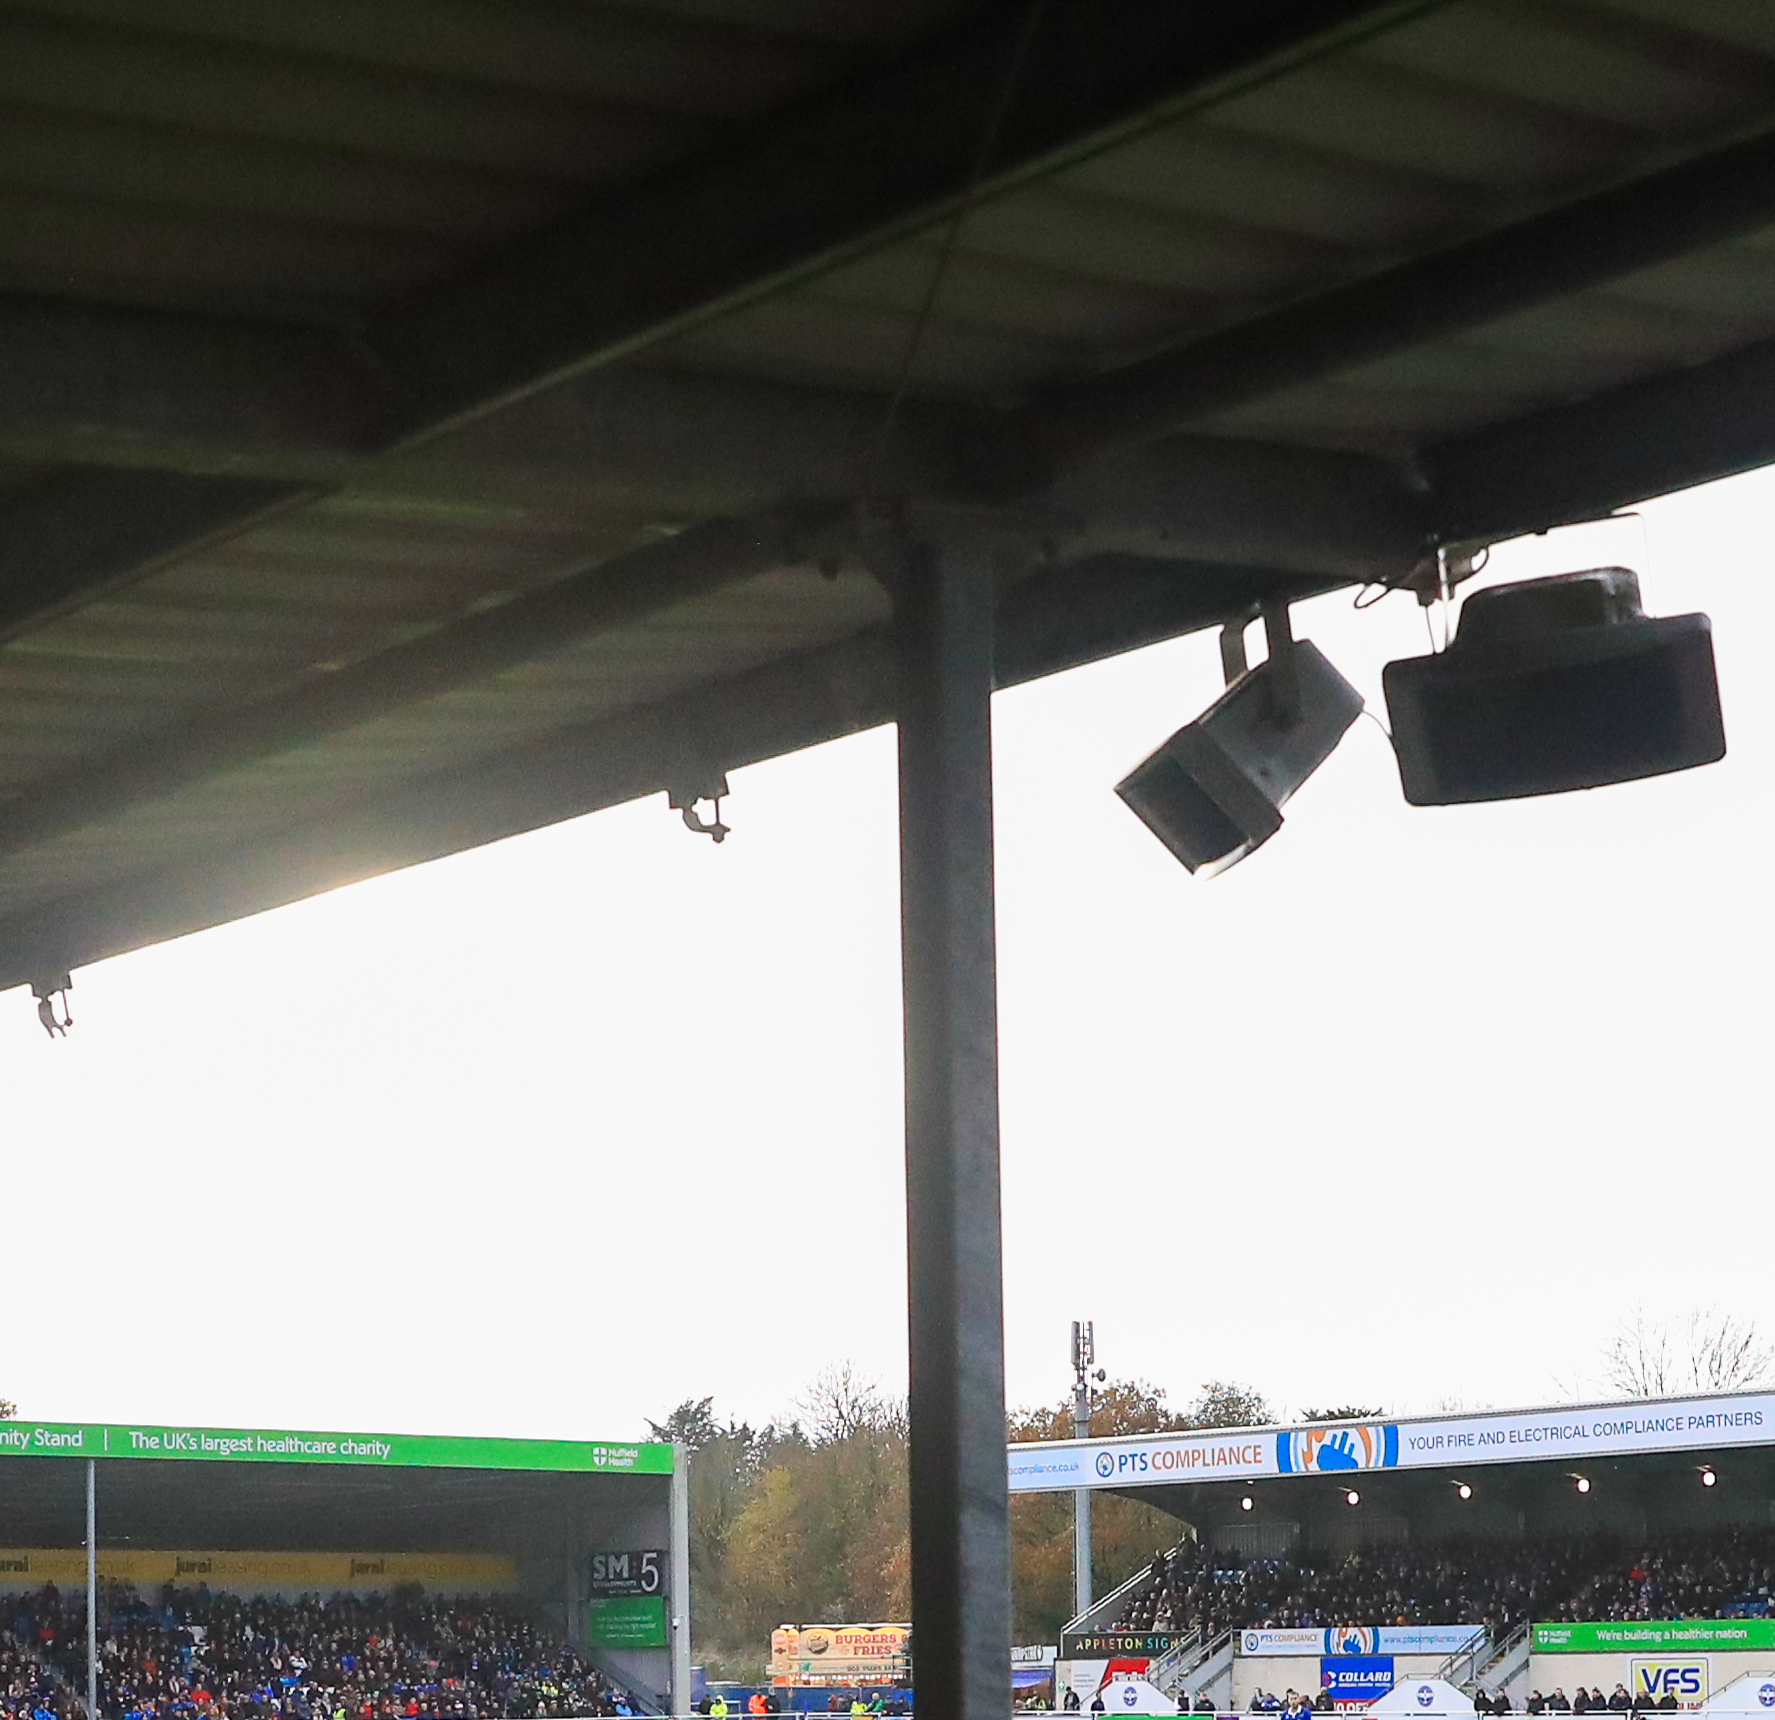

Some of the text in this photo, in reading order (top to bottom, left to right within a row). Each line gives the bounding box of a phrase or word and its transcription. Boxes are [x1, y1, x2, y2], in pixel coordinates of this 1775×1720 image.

[34, 1428, 83, 1447] Stand
[1409, 1411, 1763, 1450] YOUR FIRE AND ELECTRICAL COMPLIANCE PARTNERS
[129, 1431, 160, 1449] The
[201, 1434, 253, 1456] largest
[256, 1435, 337, 1454] healthcare
[340, 1439, 392, 1459] charity
[1009, 1445, 1262, 1478] scompliance.co.uk PTS COMPLIANCE
[835, 1634, 896, 1645] BURGERS
[1624, 1629, 1661, 1641] building
[1673, 1629, 1714, 1639] healthier
[1715, 1628, 1747, 1638] nation
[854, 1645, 891, 1655] FRIES
[1076, 1637, 1142, 1650] APPLETON
[1339, 1671, 1392, 1682] COLLARD
[1641, 1668, 1701, 1694] VFS
